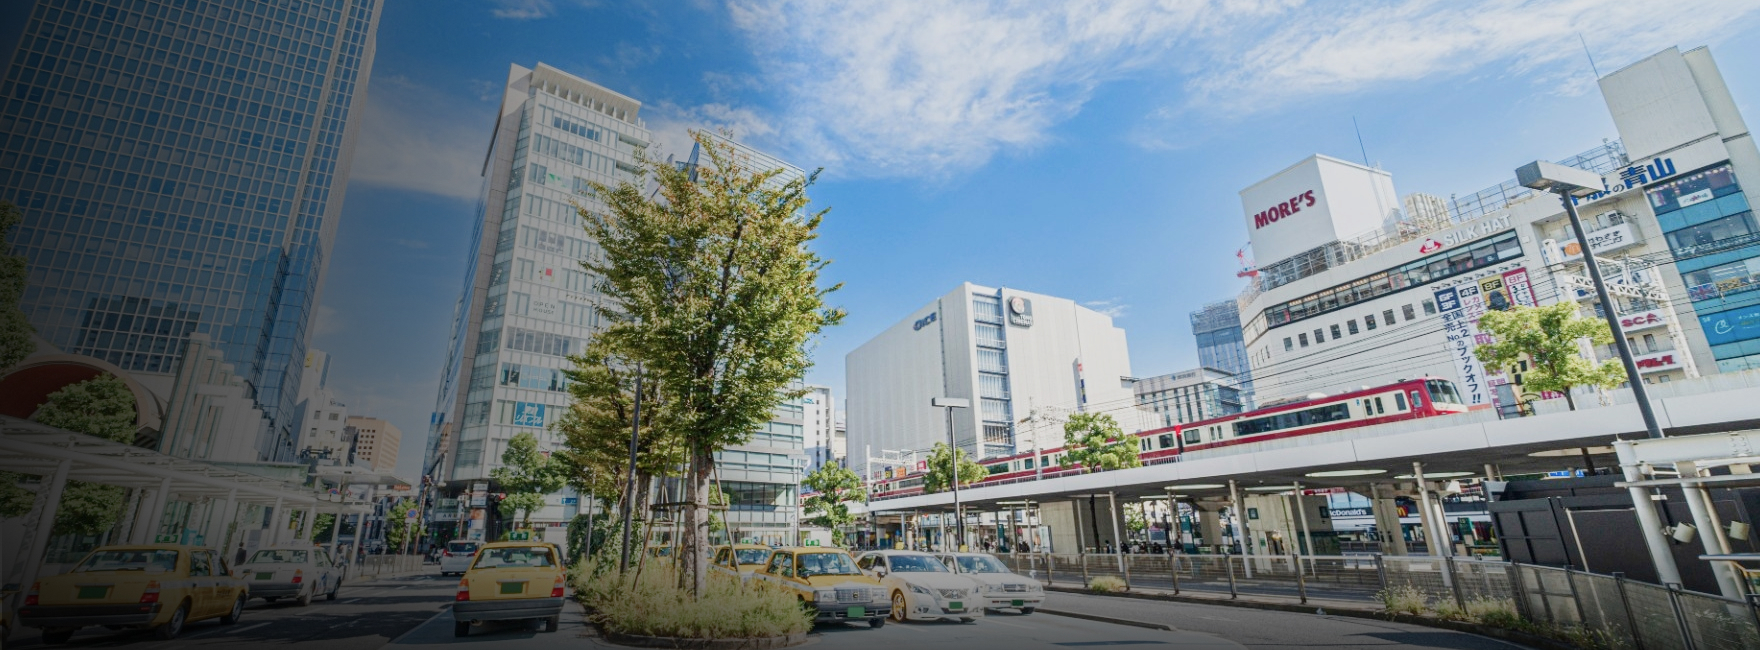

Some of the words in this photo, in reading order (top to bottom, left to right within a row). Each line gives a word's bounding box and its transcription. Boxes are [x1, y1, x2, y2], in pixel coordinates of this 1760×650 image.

[1254, 189, 1316, 230] MORE'S
[1444, 219, 1480, 247] SILK
[1482, 213, 1512, 236] HAT
[1508, 275, 1524, 284] 8F
[1484, 281, 1500, 291] 8F
[1461, 286, 1477, 297] 4F
[533, 301, 556, 311] OPEN
